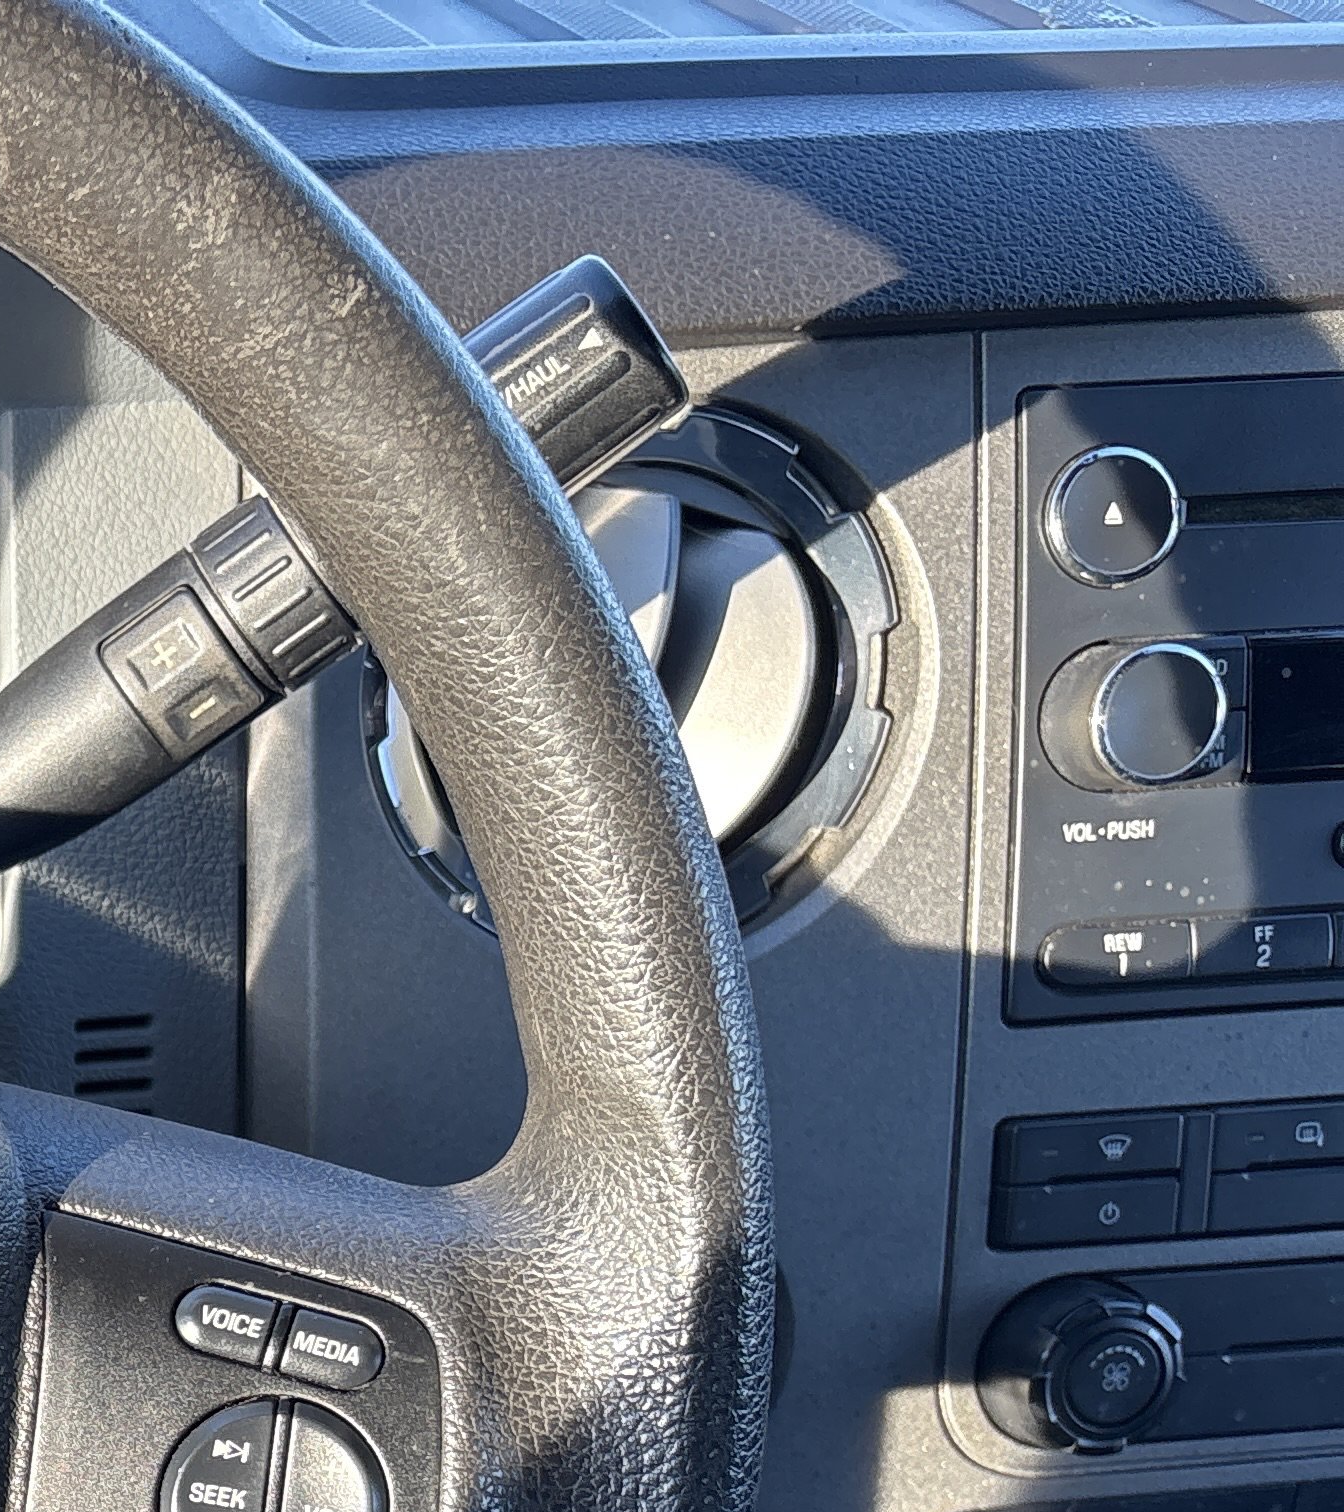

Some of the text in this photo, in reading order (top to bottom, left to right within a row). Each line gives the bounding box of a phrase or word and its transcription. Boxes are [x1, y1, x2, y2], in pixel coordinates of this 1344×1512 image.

[499, 356, 571, 409] /HAUL
[1103, 932, 1143, 952] REW
[1253, 924, 1275, 943] FF
[1117, 952, 1128, 977] 1
[1255, 944, 1273, 968] 2
[201, 1304, 265, 1338] VOICE
[292, 1331, 361, 1368] MEDIA
[188, 1482, 247, 1510] SEEK
